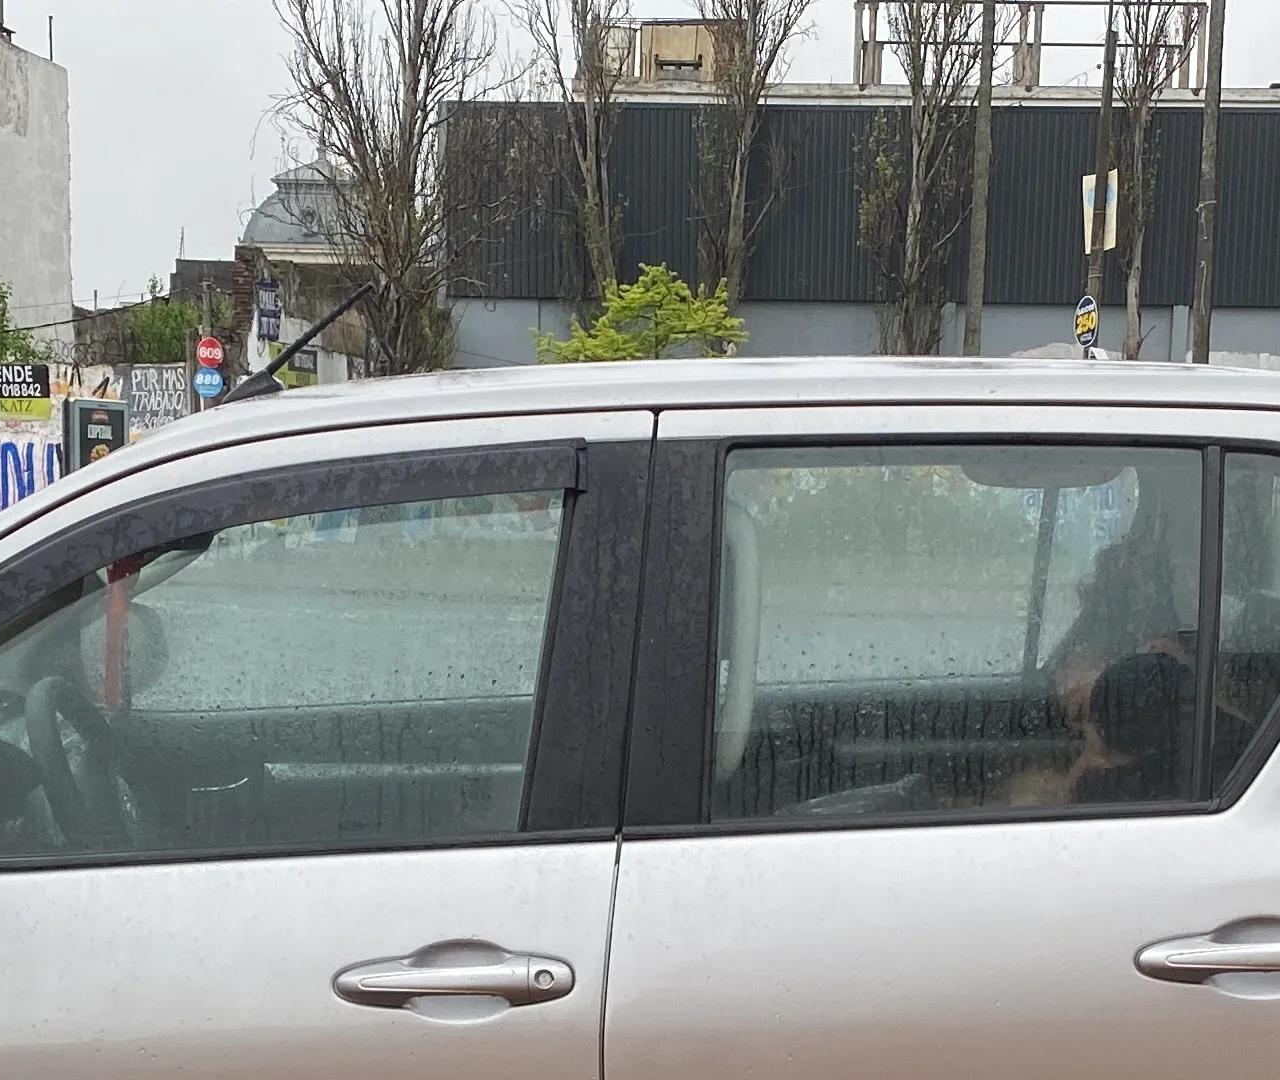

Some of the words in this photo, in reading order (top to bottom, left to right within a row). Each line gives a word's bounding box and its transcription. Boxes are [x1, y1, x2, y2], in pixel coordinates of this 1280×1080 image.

[1076, 311, 1096, 335] 250
[199, 347, 221, 360] 609
[131, 368, 159, 391] POR
[163, 368, 186, 391] MAS
[1, 400, 33, 413] KATZ
[131, 391, 184, 411] TRABAJO
